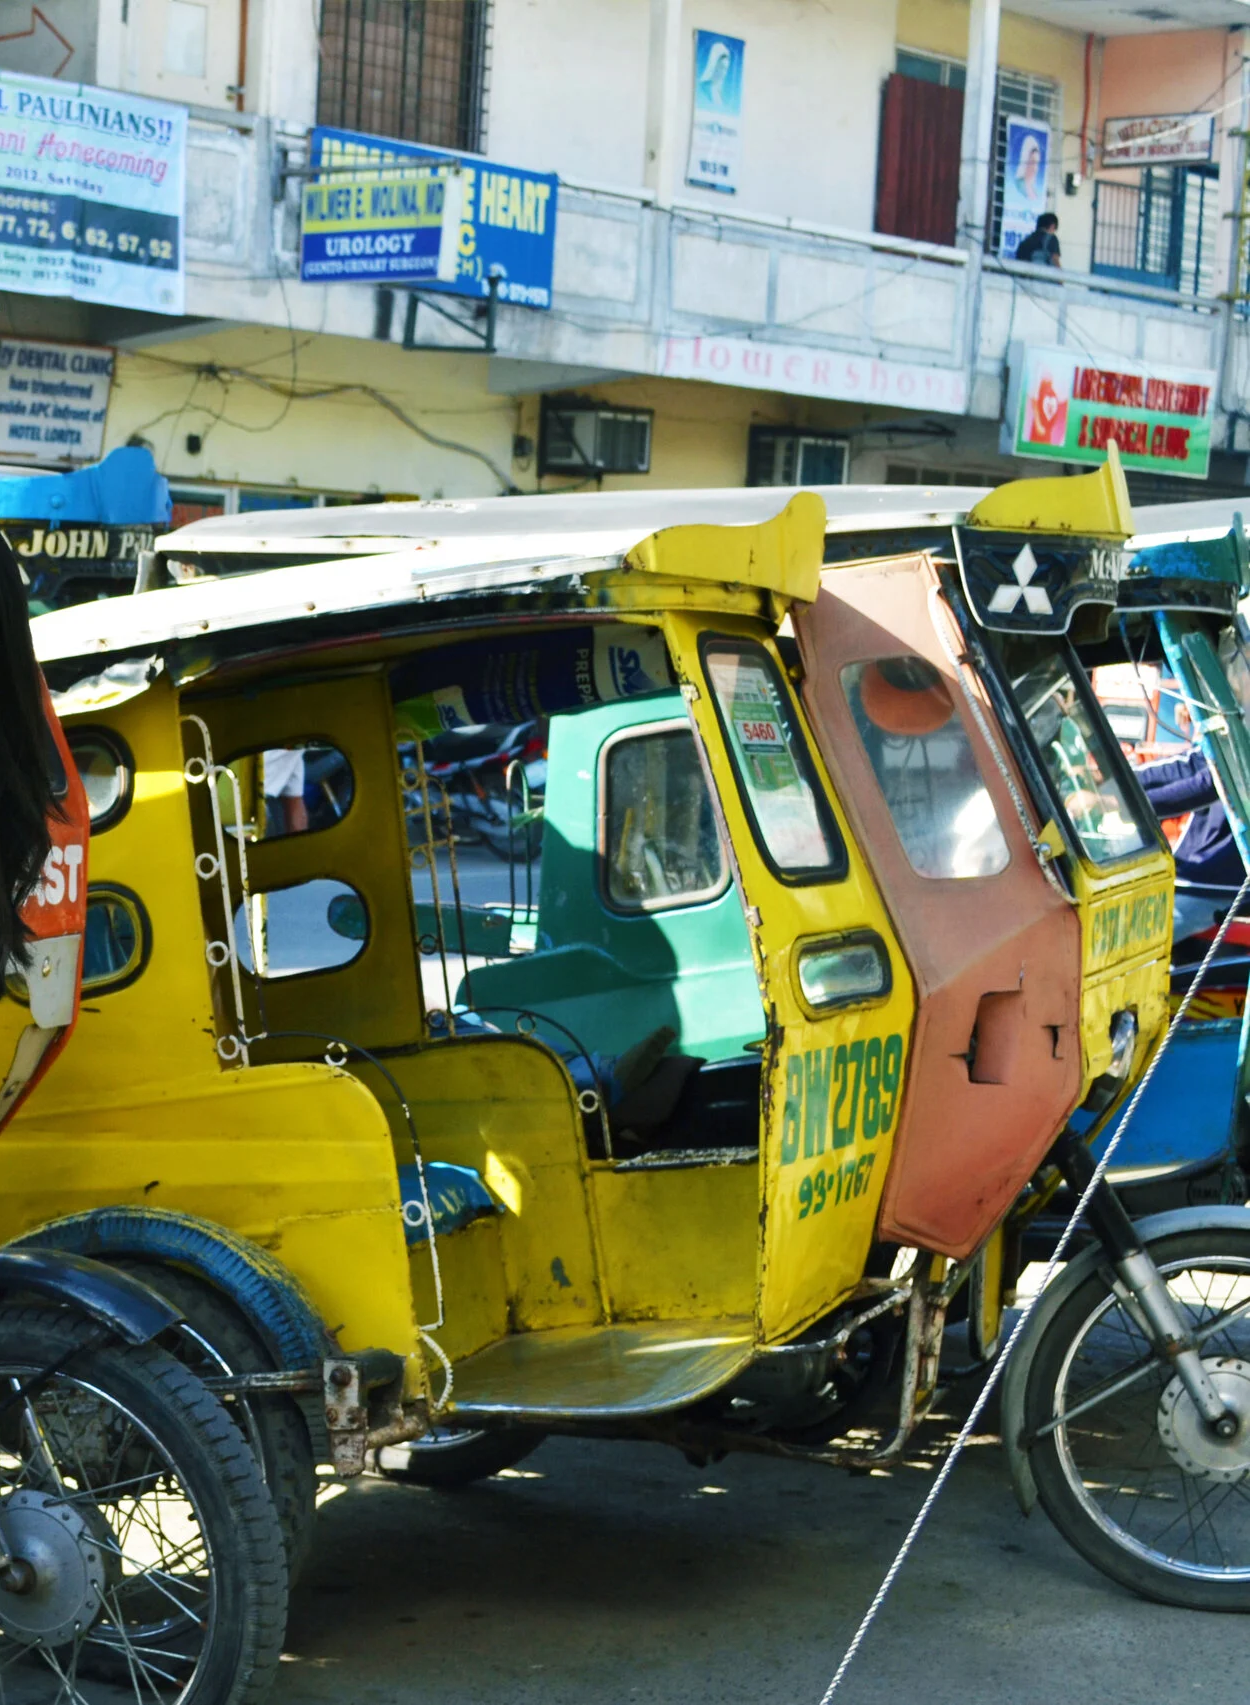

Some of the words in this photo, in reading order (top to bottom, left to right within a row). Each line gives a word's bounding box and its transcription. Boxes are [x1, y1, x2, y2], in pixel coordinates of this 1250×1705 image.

[478, 170, 551, 235] HEART
[325, 233, 416, 257] UROLOGY
[17, 529, 110, 559] JOHN
[780, 1033, 903, 1167] BW2789
[798, 1152, 876, 1221] 93-1767
